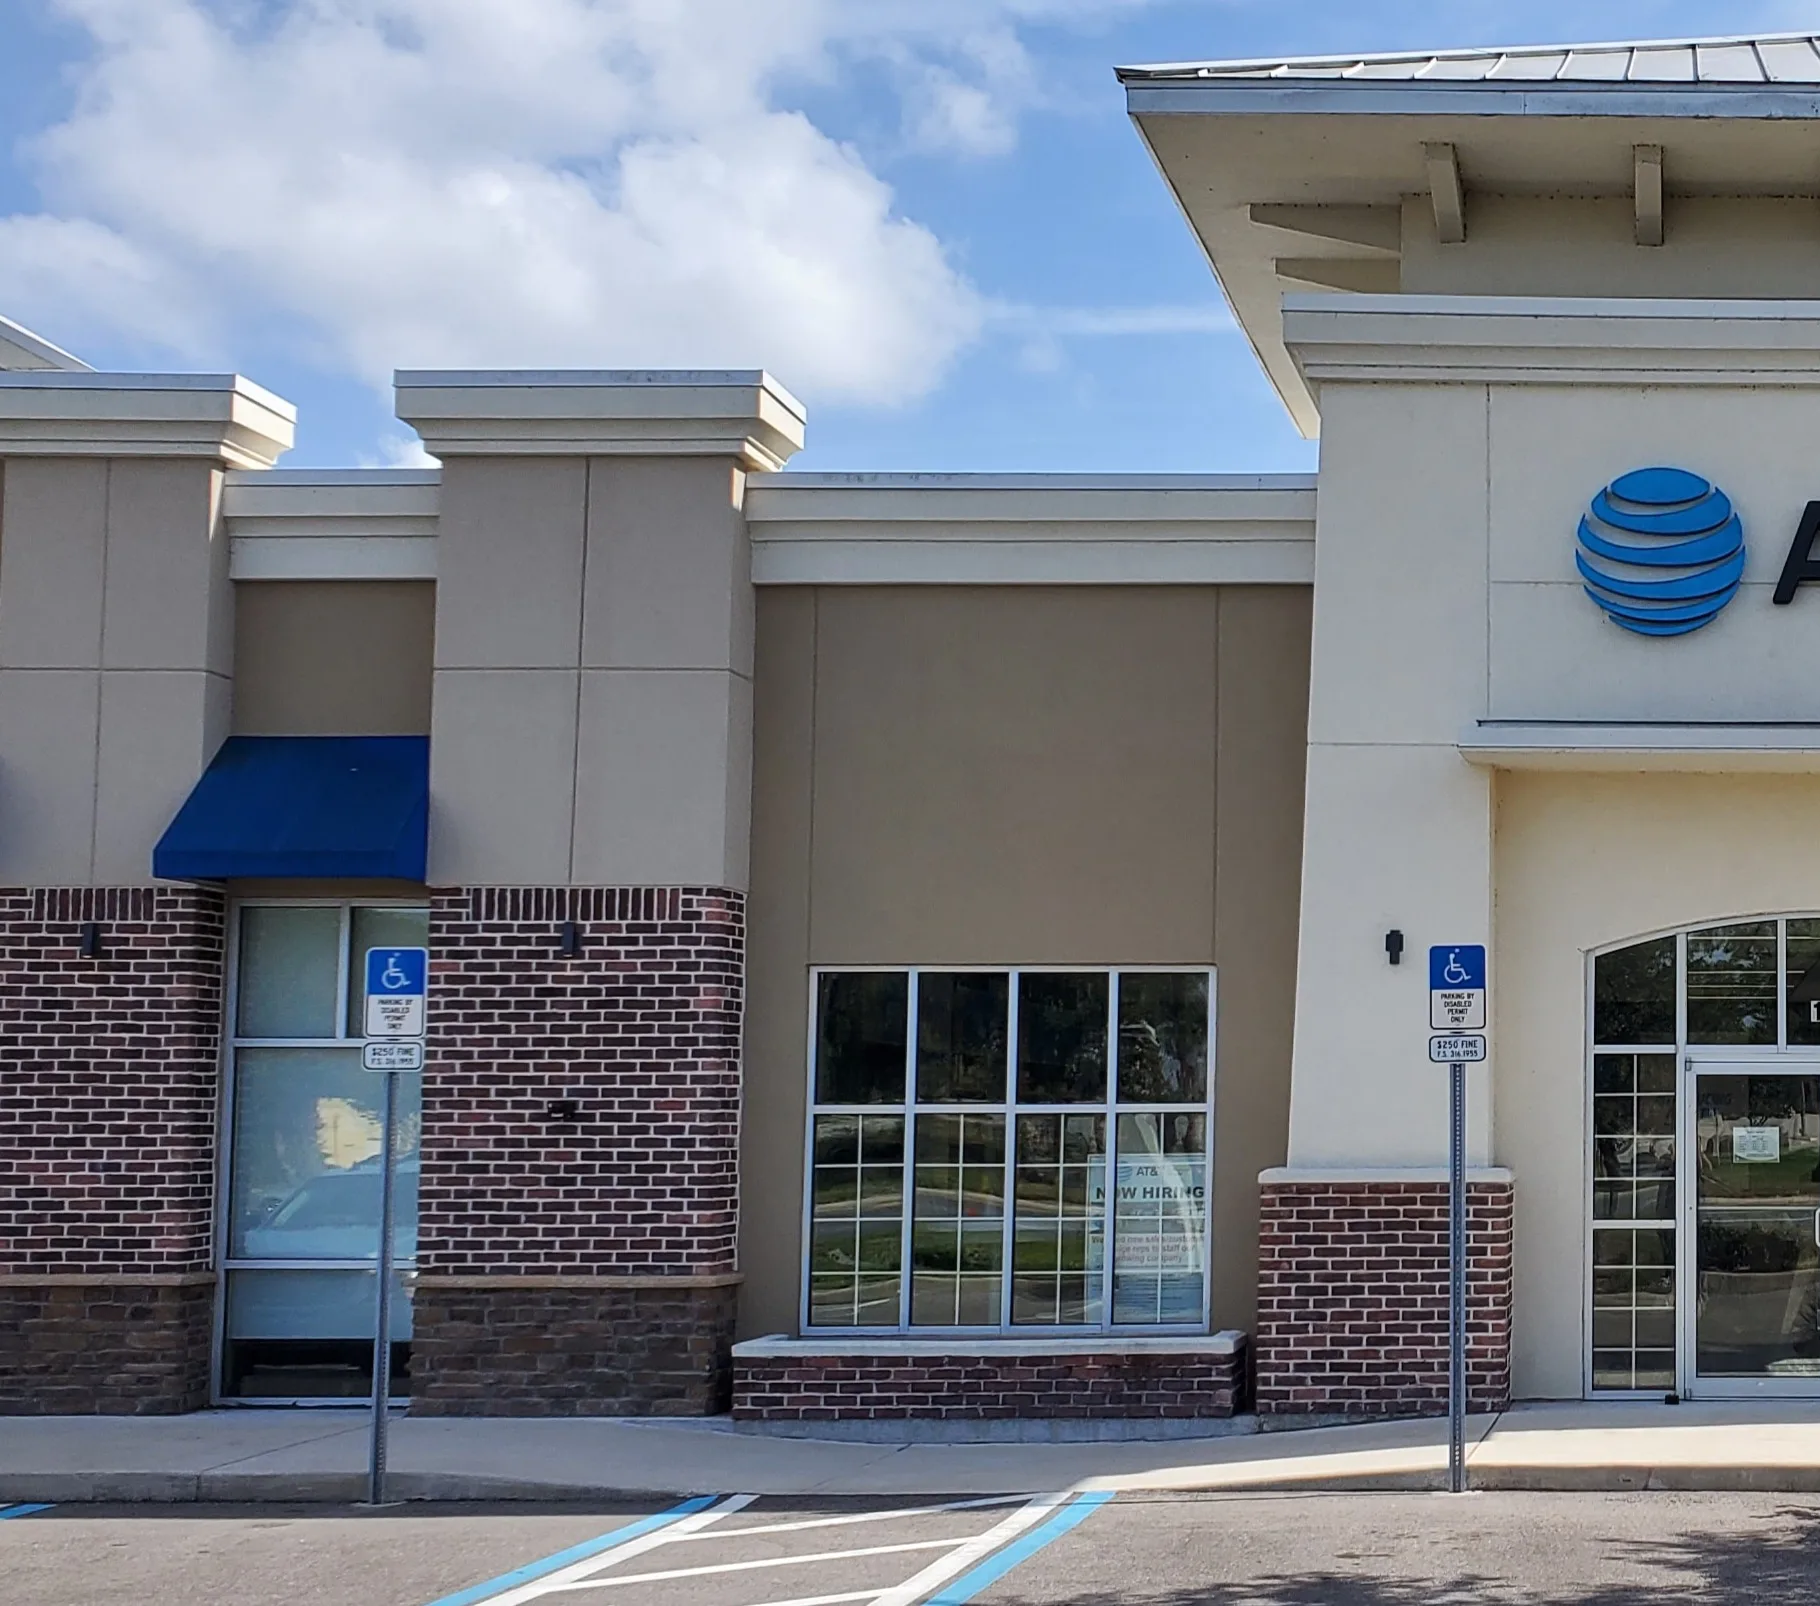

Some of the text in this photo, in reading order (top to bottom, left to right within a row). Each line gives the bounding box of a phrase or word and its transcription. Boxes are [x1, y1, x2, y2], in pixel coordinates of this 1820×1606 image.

[1443, 1000, 1472, 1008] DISABLED
[1437, 1040, 1478, 1049] $250 FINE
[372, 1048, 394, 1056] $250
[1136, 1166, 1159, 1177] AT&
[1096, 1186, 1137, 1200] NW
